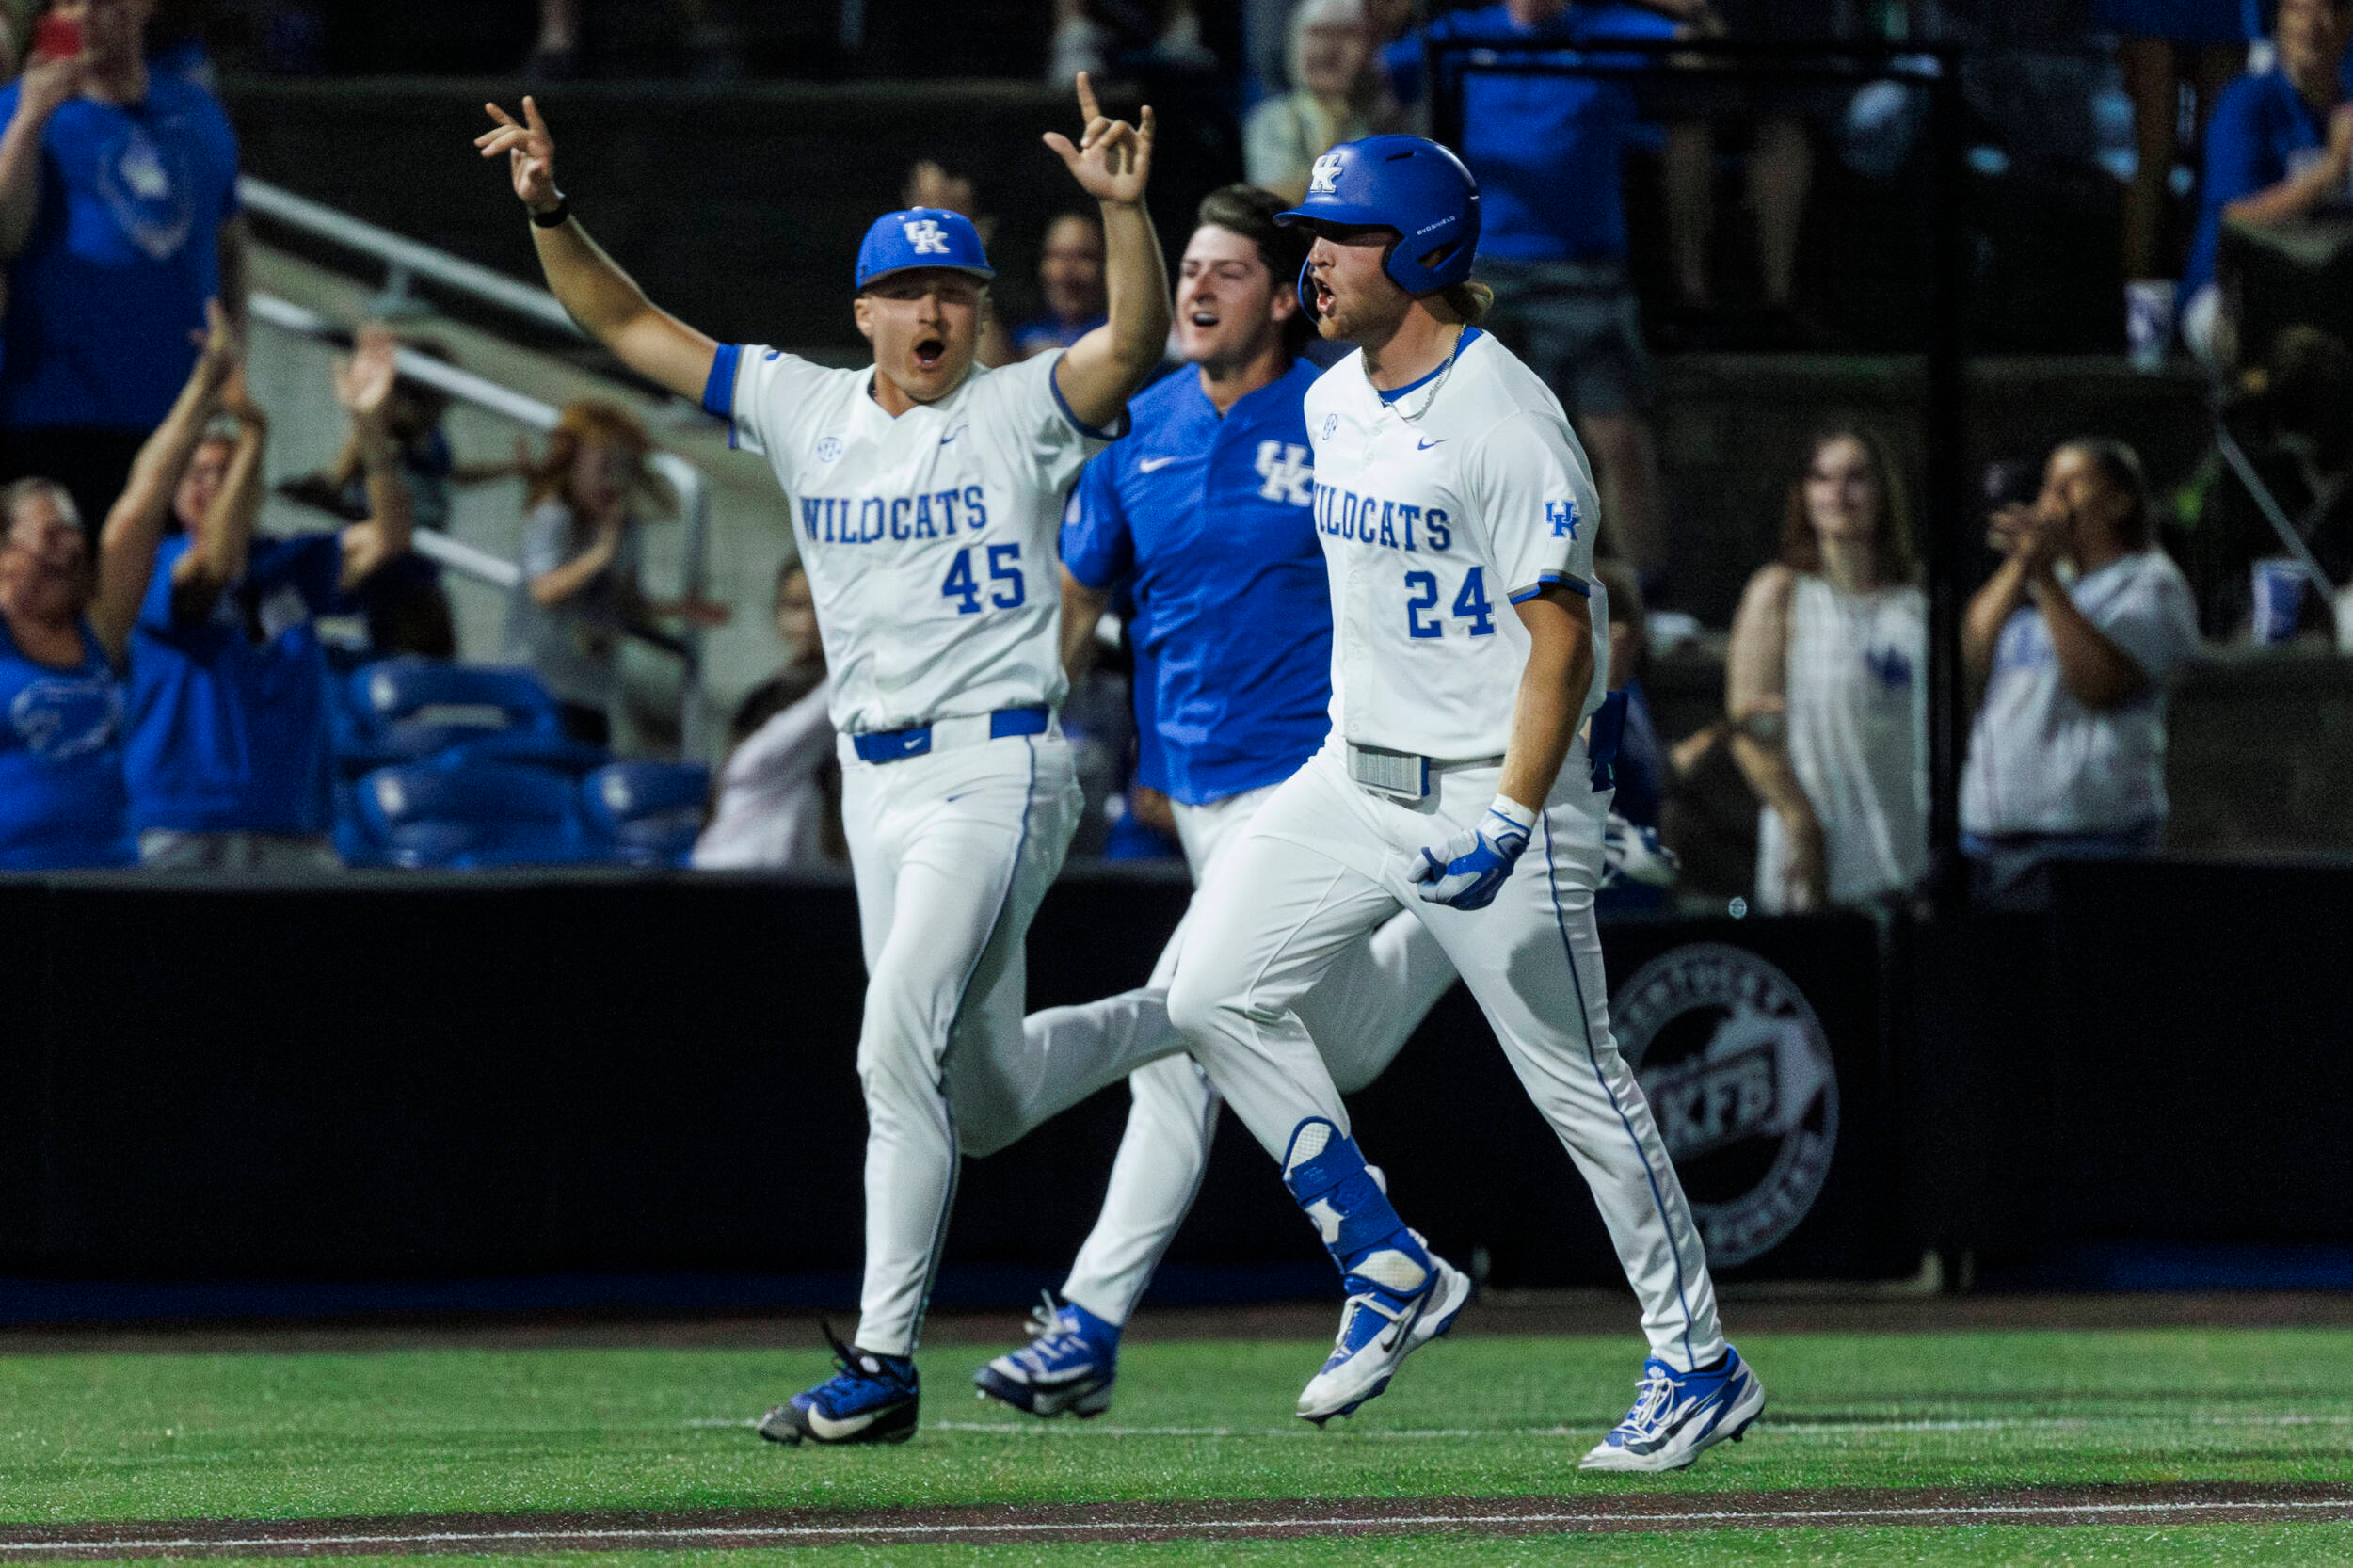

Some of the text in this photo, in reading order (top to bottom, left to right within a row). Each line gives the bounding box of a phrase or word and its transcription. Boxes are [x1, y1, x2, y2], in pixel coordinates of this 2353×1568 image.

[904, 219, 951, 255] UK
[1255, 440, 1314, 507] UK
[800, 485, 987, 544] WILDCATS
[1544, 500, 1581, 541] UK
[942, 542, 1026, 615] 45
[1404, 566, 1496, 639] 24
[1659, 1056, 1769, 1149] KFB
